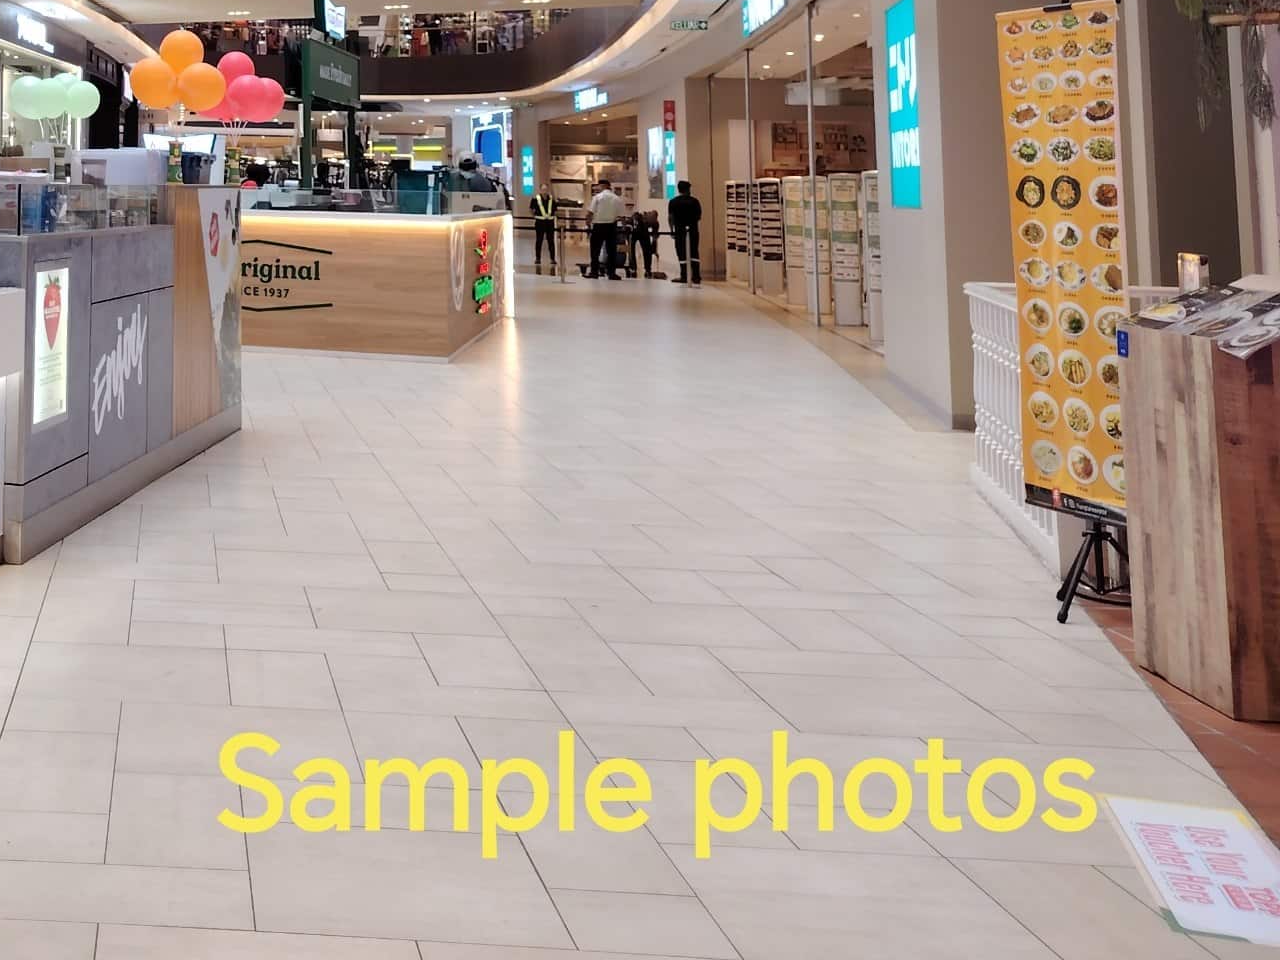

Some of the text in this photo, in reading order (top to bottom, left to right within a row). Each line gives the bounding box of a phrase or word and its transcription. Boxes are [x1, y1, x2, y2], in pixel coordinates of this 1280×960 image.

[241, 257, 321, 283] riginal
[243, 286, 290, 298] CE 1937
[92, 303, 148, 435] Enjoy
[1184, 825, 1229, 848] Use
[1135, 822, 1215, 904] Voucher Here
[1200, 851, 1248, 880] Your
